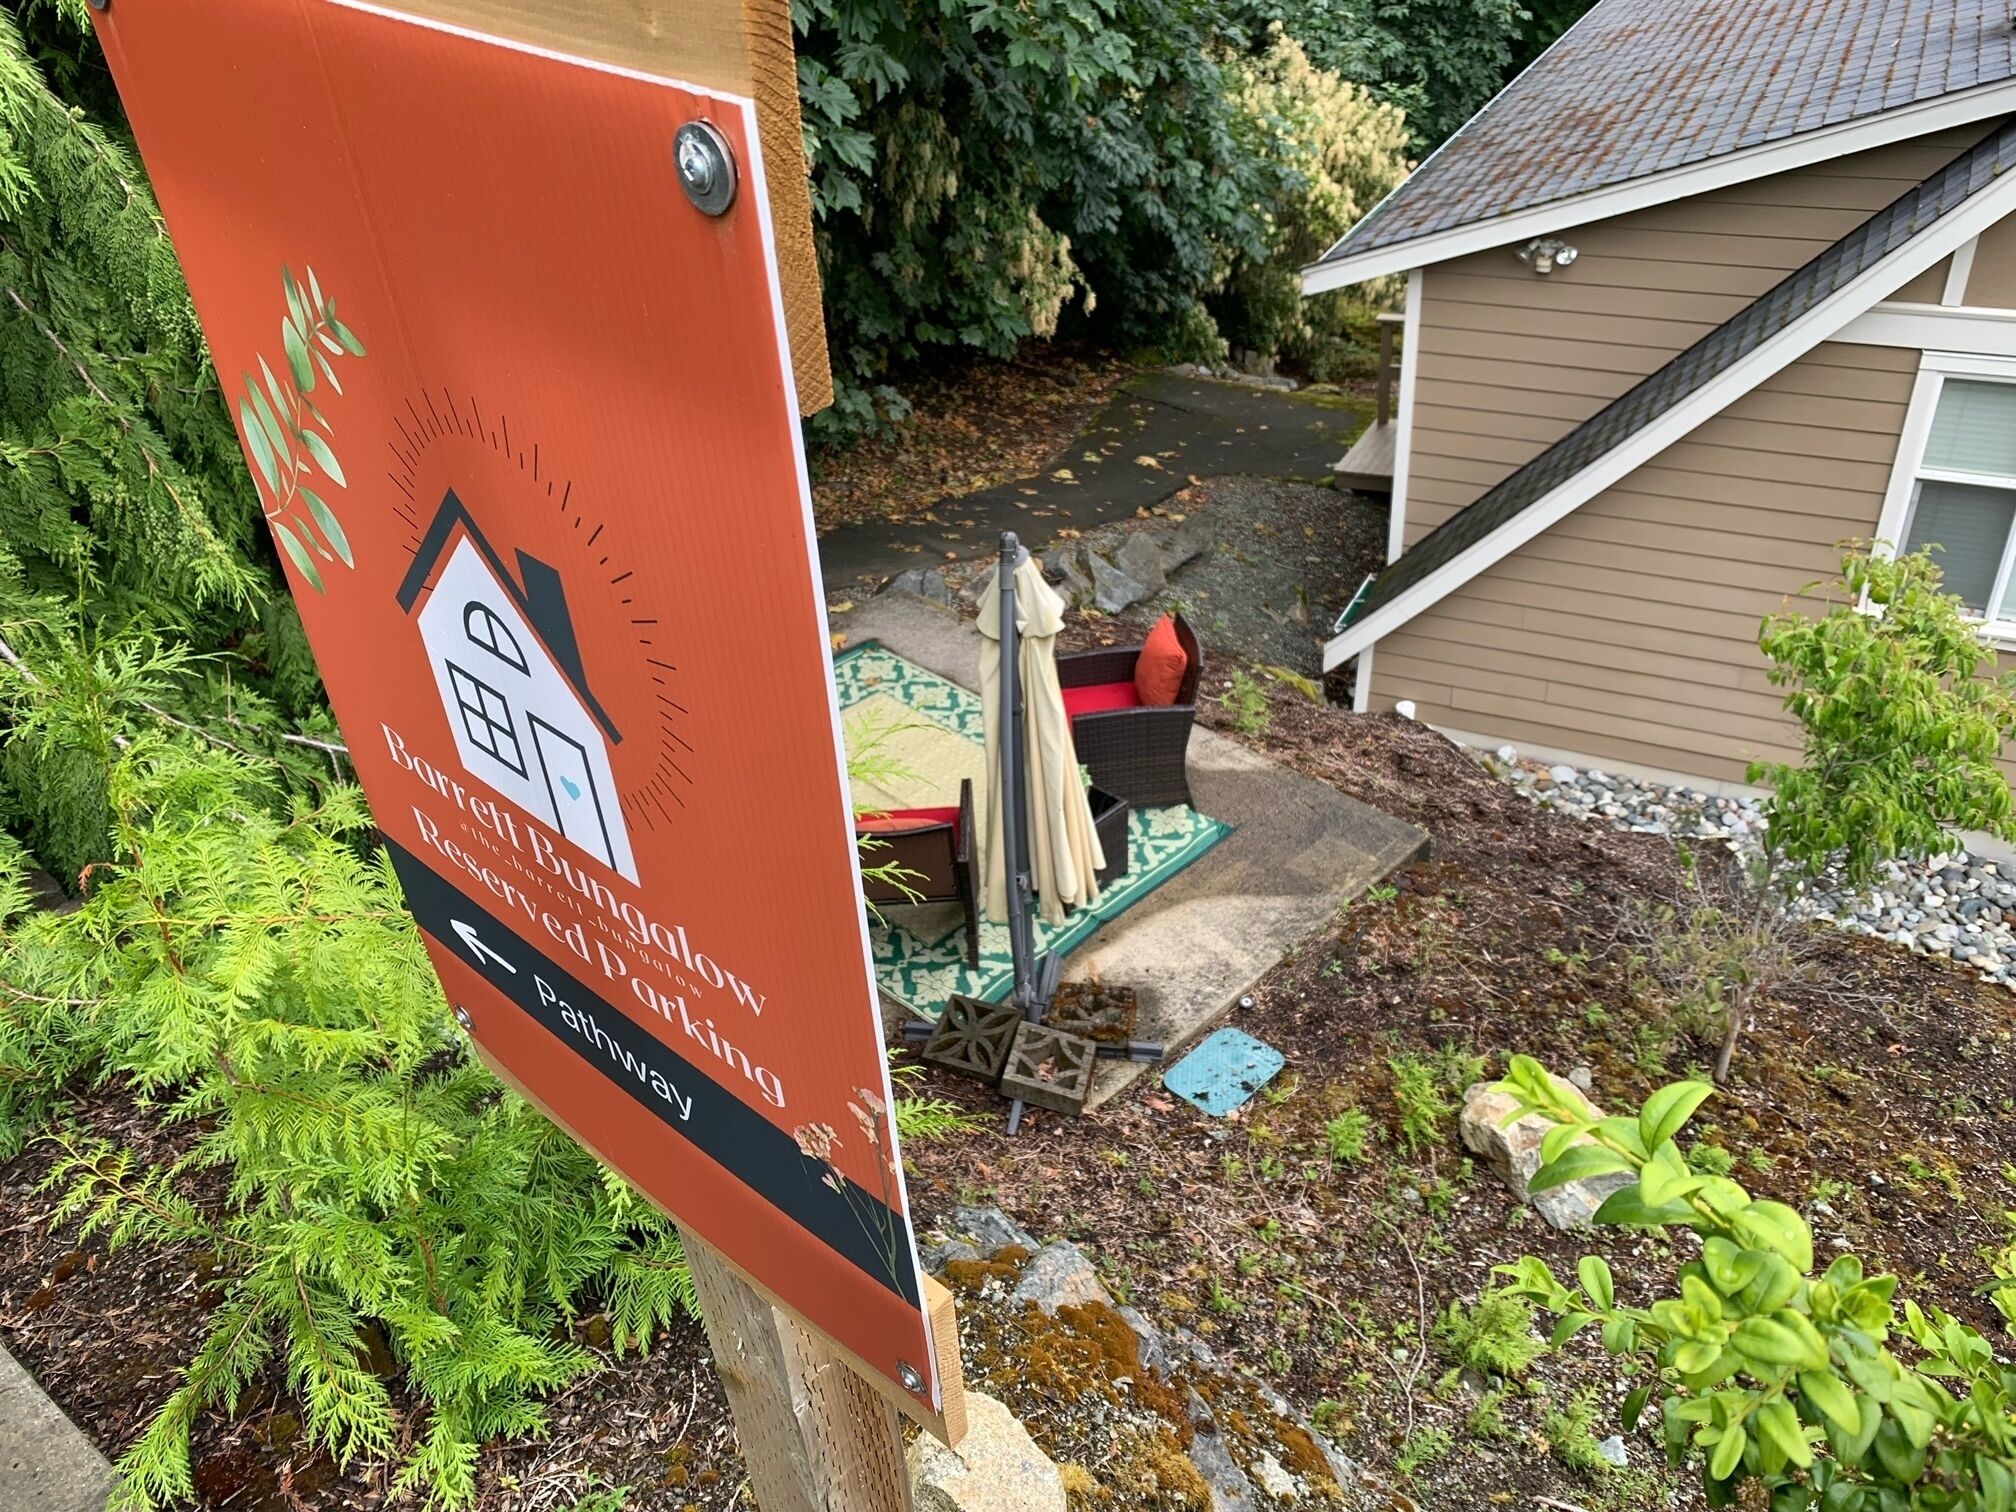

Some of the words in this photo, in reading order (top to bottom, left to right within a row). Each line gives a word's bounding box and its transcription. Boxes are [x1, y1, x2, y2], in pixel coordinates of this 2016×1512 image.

[380, 722, 524, 853] Barrett
[524, 822, 767, 1018] Bungalow
[411, 806, 592, 965] Reserved
[596, 939, 787, 1109] Parking
[533, 974, 694, 1121] Pathway
